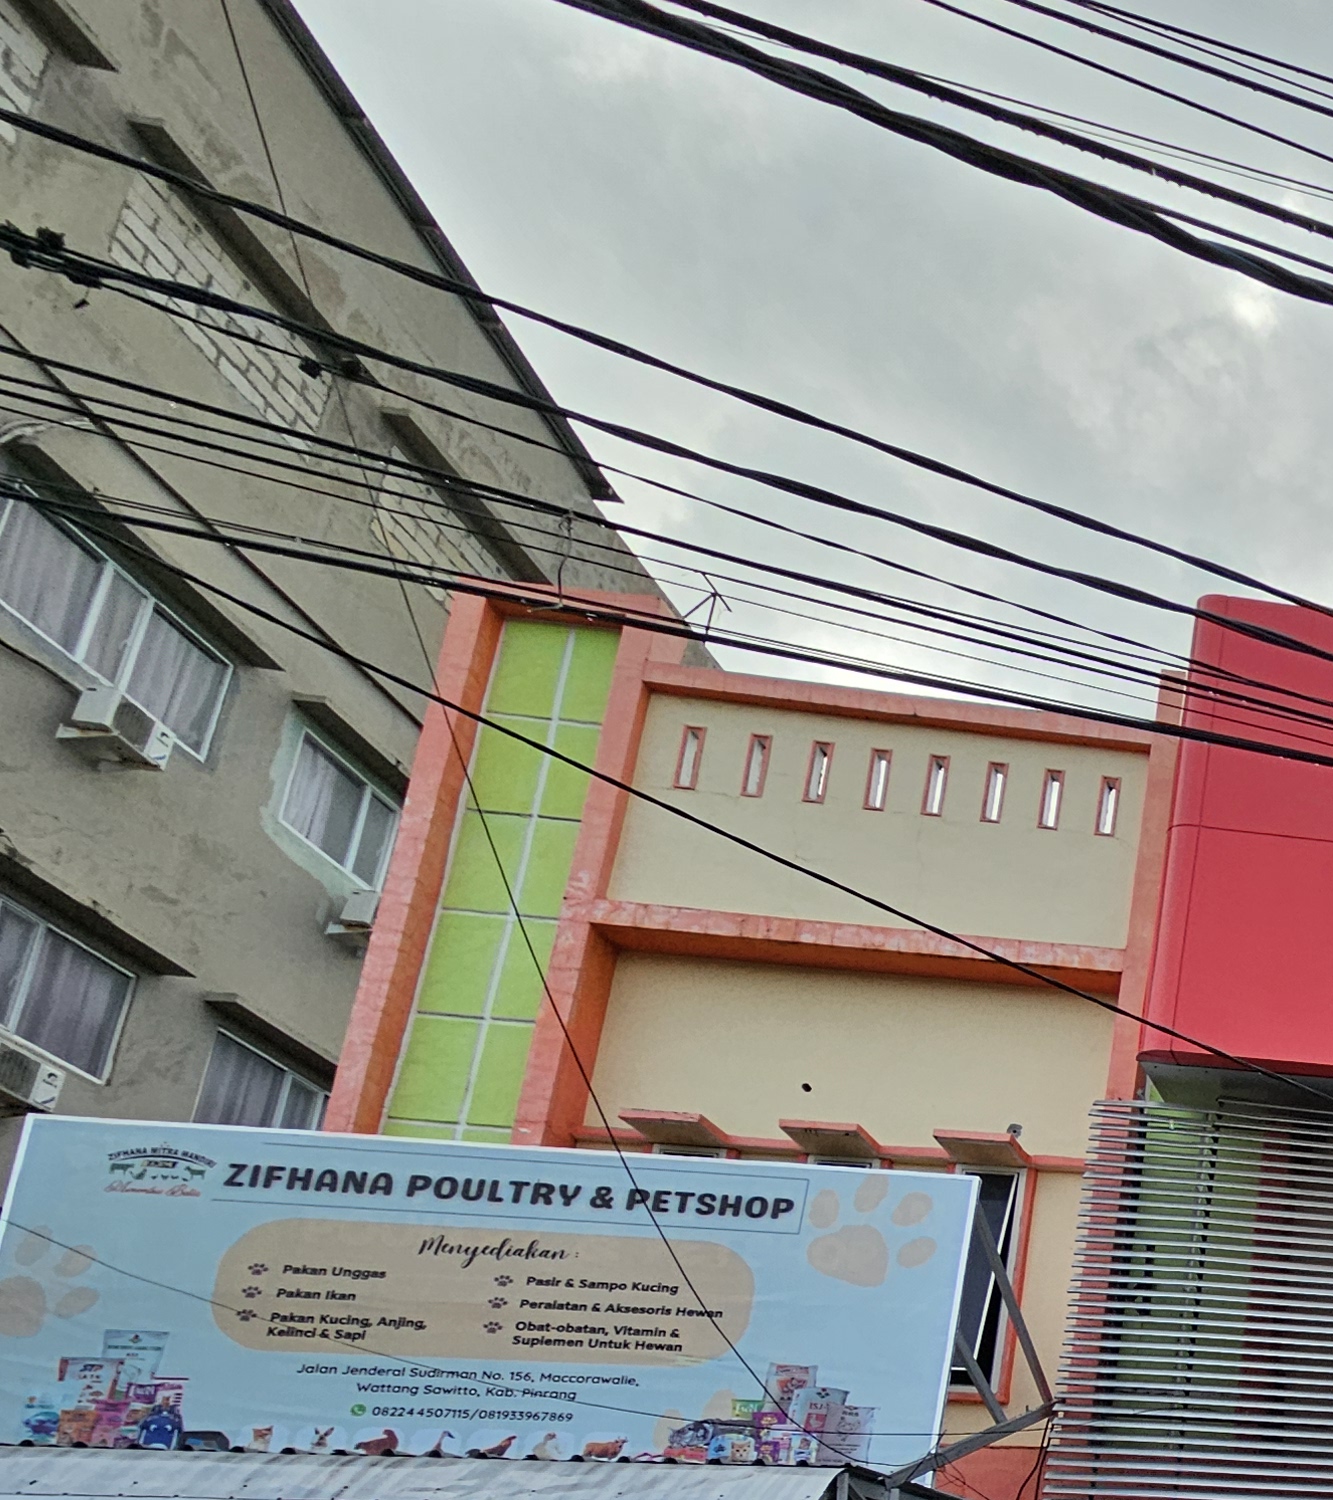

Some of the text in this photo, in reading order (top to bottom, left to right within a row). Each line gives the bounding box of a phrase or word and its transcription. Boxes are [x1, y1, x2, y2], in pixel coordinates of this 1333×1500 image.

[223, 1163, 393, 1197] ZIFHANA
[406, 1174, 582, 1208] POULTRY
[589, 1186, 614, 1210] &
[625, 1188, 795, 1220] PETSHOP
[418, 1234, 570, 1269] Menyediakan
[283, 1264, 386, 1280] Pakan Unggas
[277, 1288, 356, 1302] Pakan Ikan
[526, 1276, 679, 1296] Pasir & Sampo Kucing
[520, 1299, 723, 1319] Peralatan & Aksesoris Hewan
[270, 1312, 427, 1332] Pakan Kucing, Anjing,
[515, 1321, 680, 1339] Obat-obatan, Vitamin &
[266, 1326, 366, 1343] Kelinci & Sapi
[512, 1335, 683, 1353] Suplemen Untuk Hewan
[297, 1364, 338, 1376] Jalan
[342, 1365, 406, 1378] Jenderal
[409, 1367, 477, 1381] Sudirman
[482, 1371, 506, 1382] No.
[510, 1371, 534, 1384] 156,
[357, 1383, 577, 1403] Wattang Sawitto, Kab. Pinrang
[372, 1406, 573, 1423] 082244507115/081933967869
